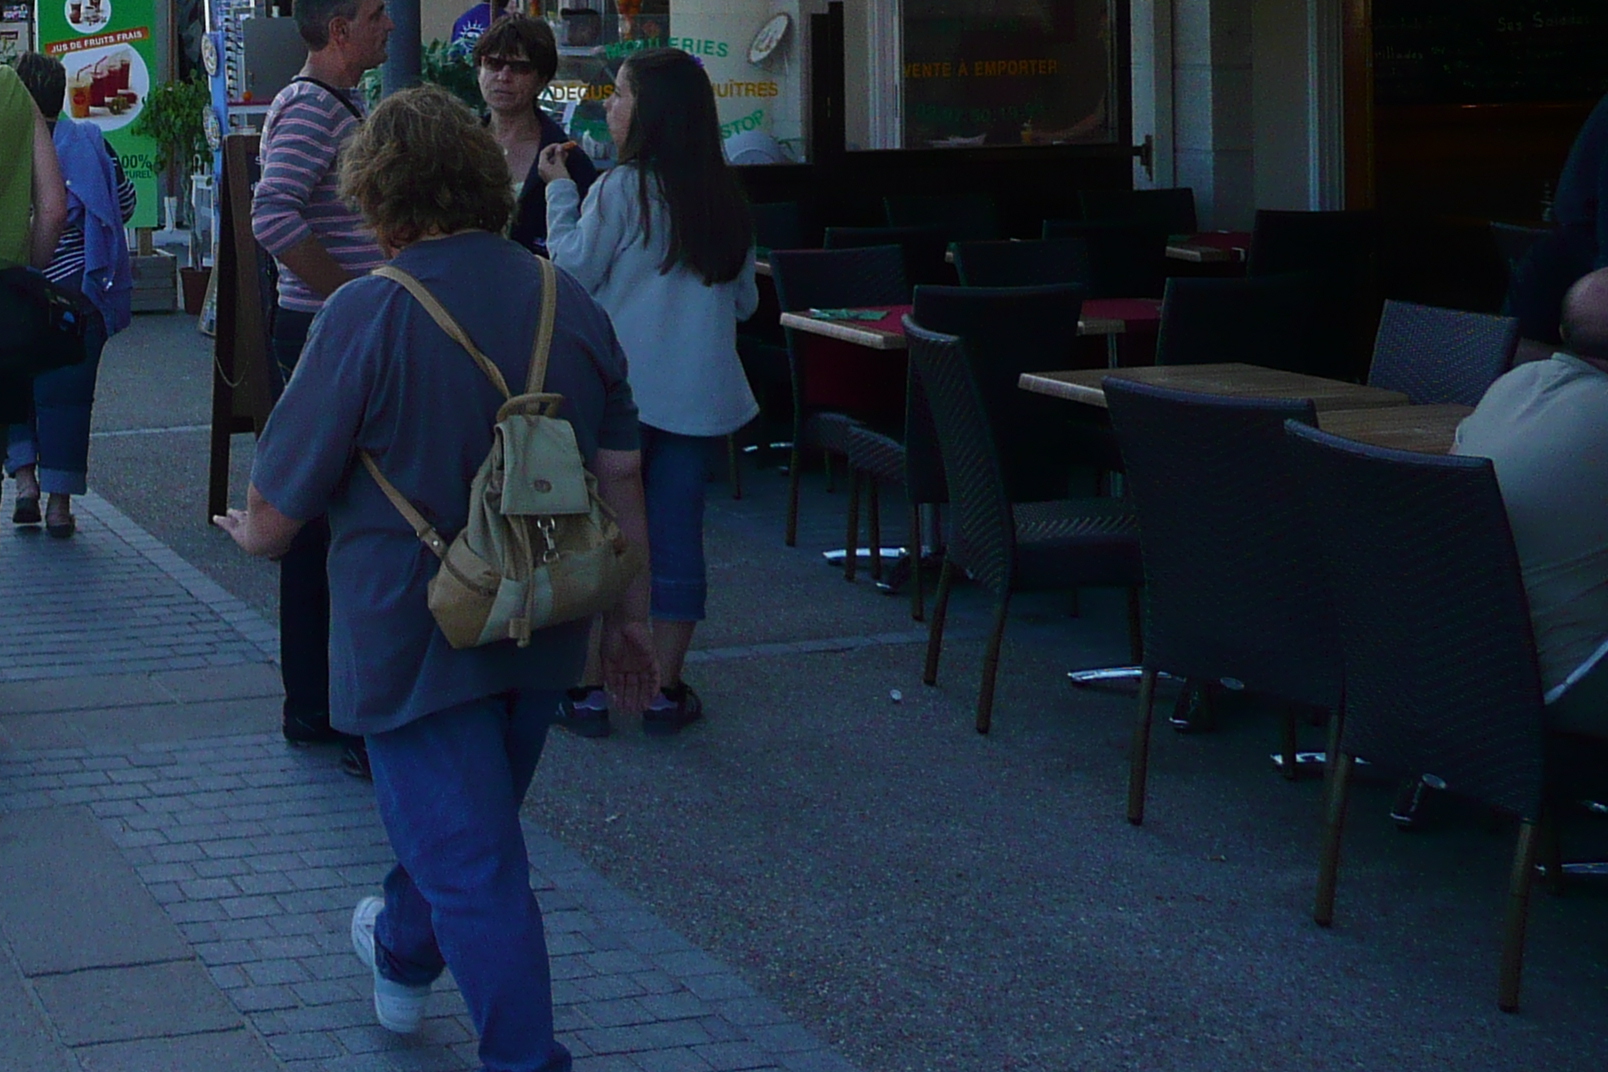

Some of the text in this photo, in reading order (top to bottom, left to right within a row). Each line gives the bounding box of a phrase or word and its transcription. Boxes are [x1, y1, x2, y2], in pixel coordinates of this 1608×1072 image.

[51, 30, 143, 54] JUS DE FRUITS FRAIS
[903, 61, 952, 78] VENTE
[974, 58, 1059, 77] EMPORTER
